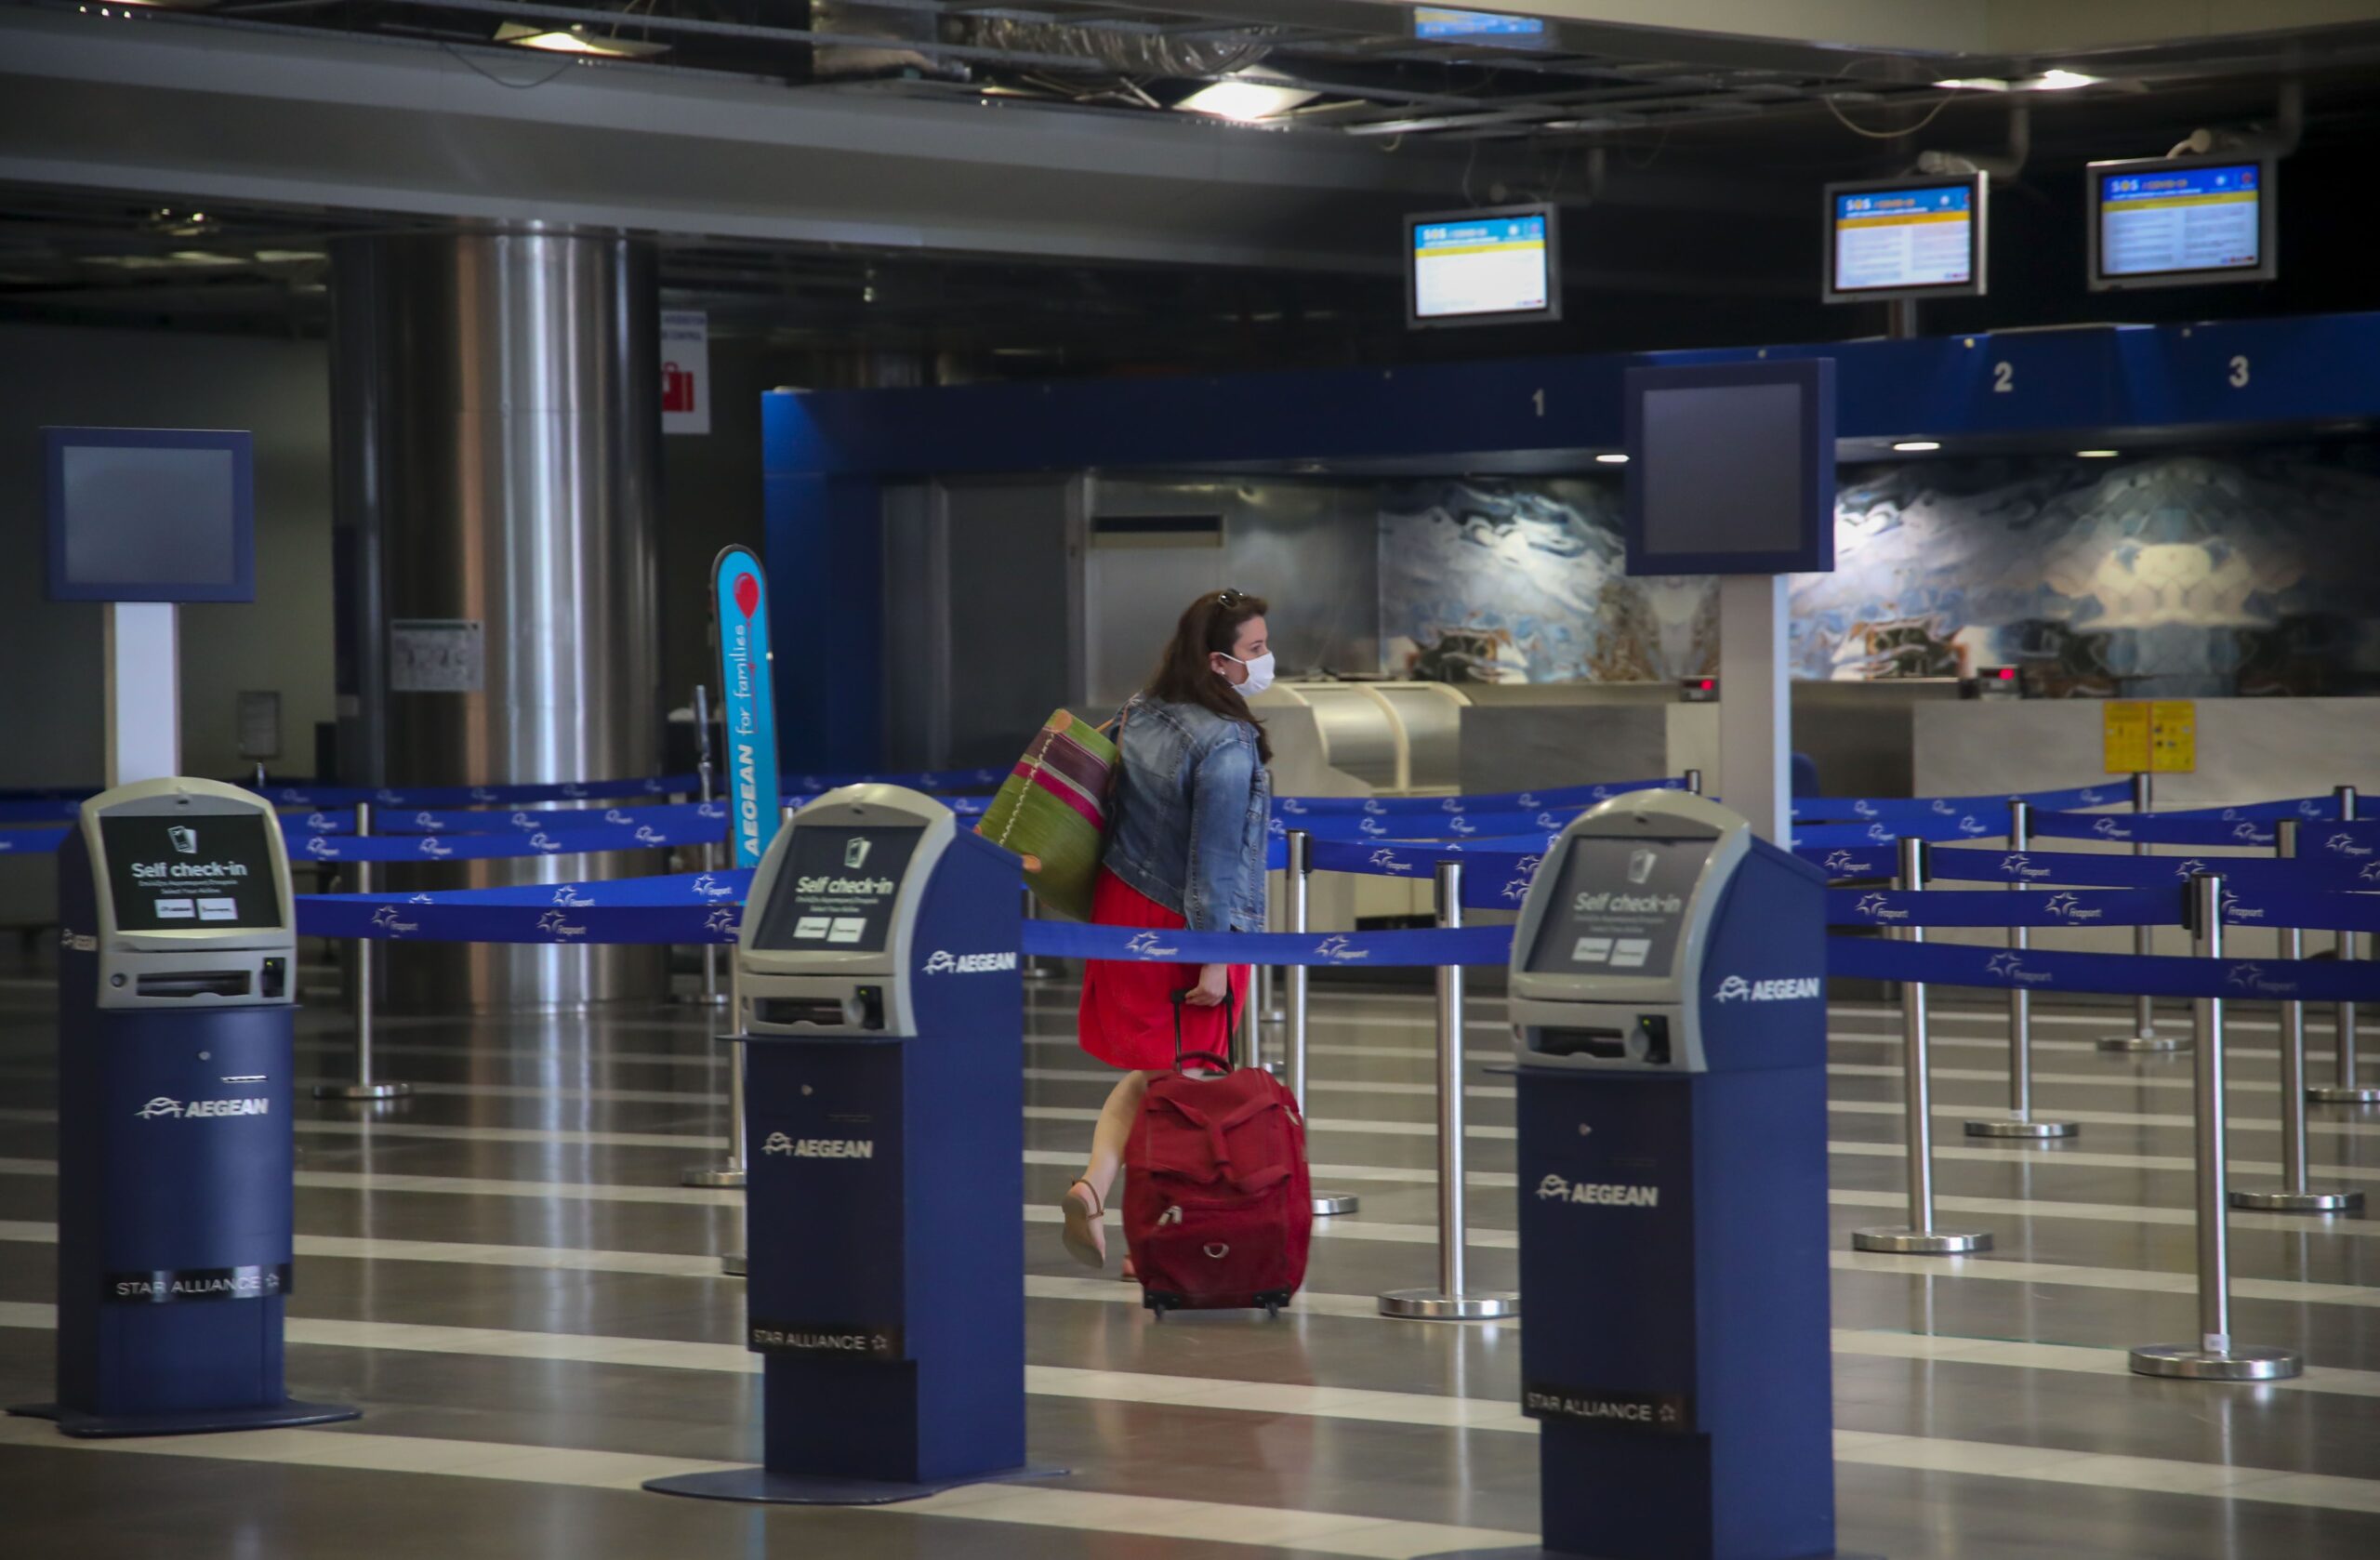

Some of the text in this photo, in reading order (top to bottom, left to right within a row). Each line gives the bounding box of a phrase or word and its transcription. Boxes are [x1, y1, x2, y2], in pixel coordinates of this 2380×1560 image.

[1845, 198, 1871, 211] SOS
[1993, 362, 2014, 392] 2
[2229, 355, 2249, 388] 3
[1532, 389, 1544, 416] 1
[728, 624, 760, 857] AEGEAN for families
[131, 860, 248, 878] Self check-in
[796, 876, 894, 894] Self check-in
[1573, 892, 1682, 912] Self check-in
[956, 951, 1017, 973] AEGEAN
[1751, 977, 1819, 1001] AEGEAN
[186, 1097, 269, 1117] AEGEAN
[793, 1139, 874, 1158] AEGEAN
[1571, 1183, 1659, 1207] AEGEAN
[116, 1276, 262, 1296] STAR ALLIANCE
[752, 1329, 866, 1351] STAR ALLIANCE
[1526, 1392, 1653, 1421] STAR ALLIANCE
